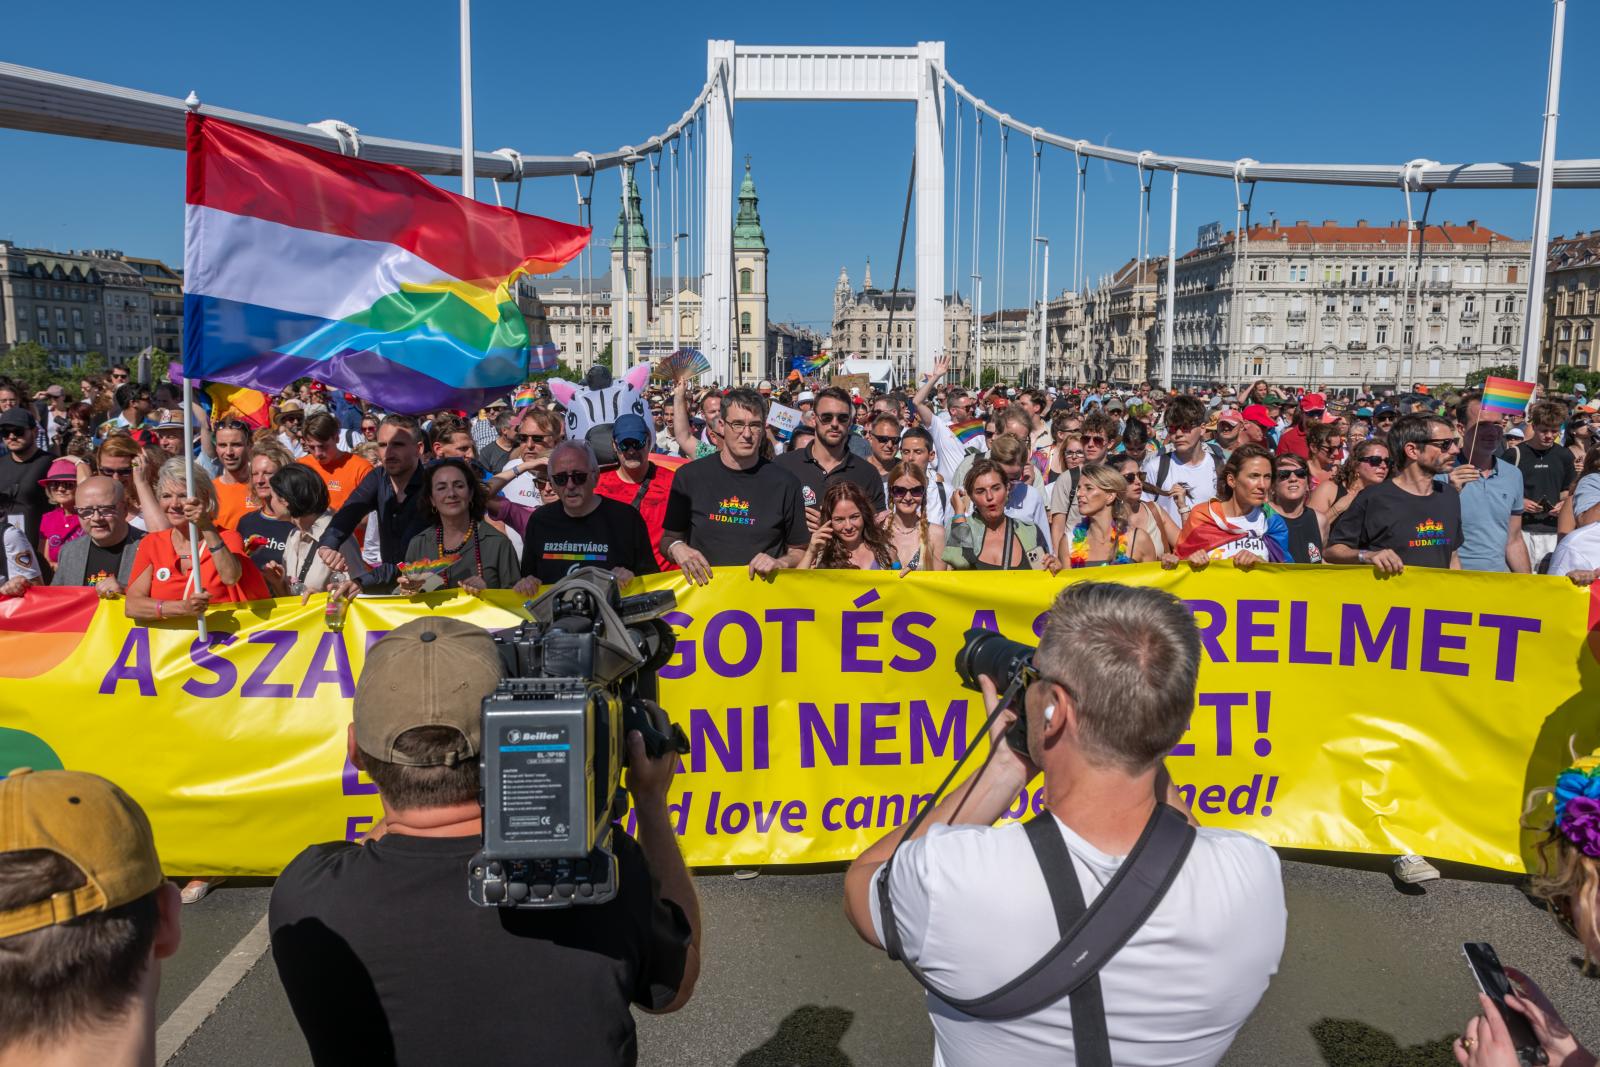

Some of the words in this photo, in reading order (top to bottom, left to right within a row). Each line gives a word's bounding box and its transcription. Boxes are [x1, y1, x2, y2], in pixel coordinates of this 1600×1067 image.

[709, 513, 756, 526] BUDAPEST
[543, 541, 609, 552] ERZSÉBETVÁROS
[1409, 537, 1451, 547] BUDAPEST
[98, 626, 158, 697] A
[841, 588, 937, 673] ÉS
[798, 699, 969, 769] NEM
[705, 791, 808, 836] love
[821, 792, 937, 832] cann
[1175, 773, 1280, 817] ned!
